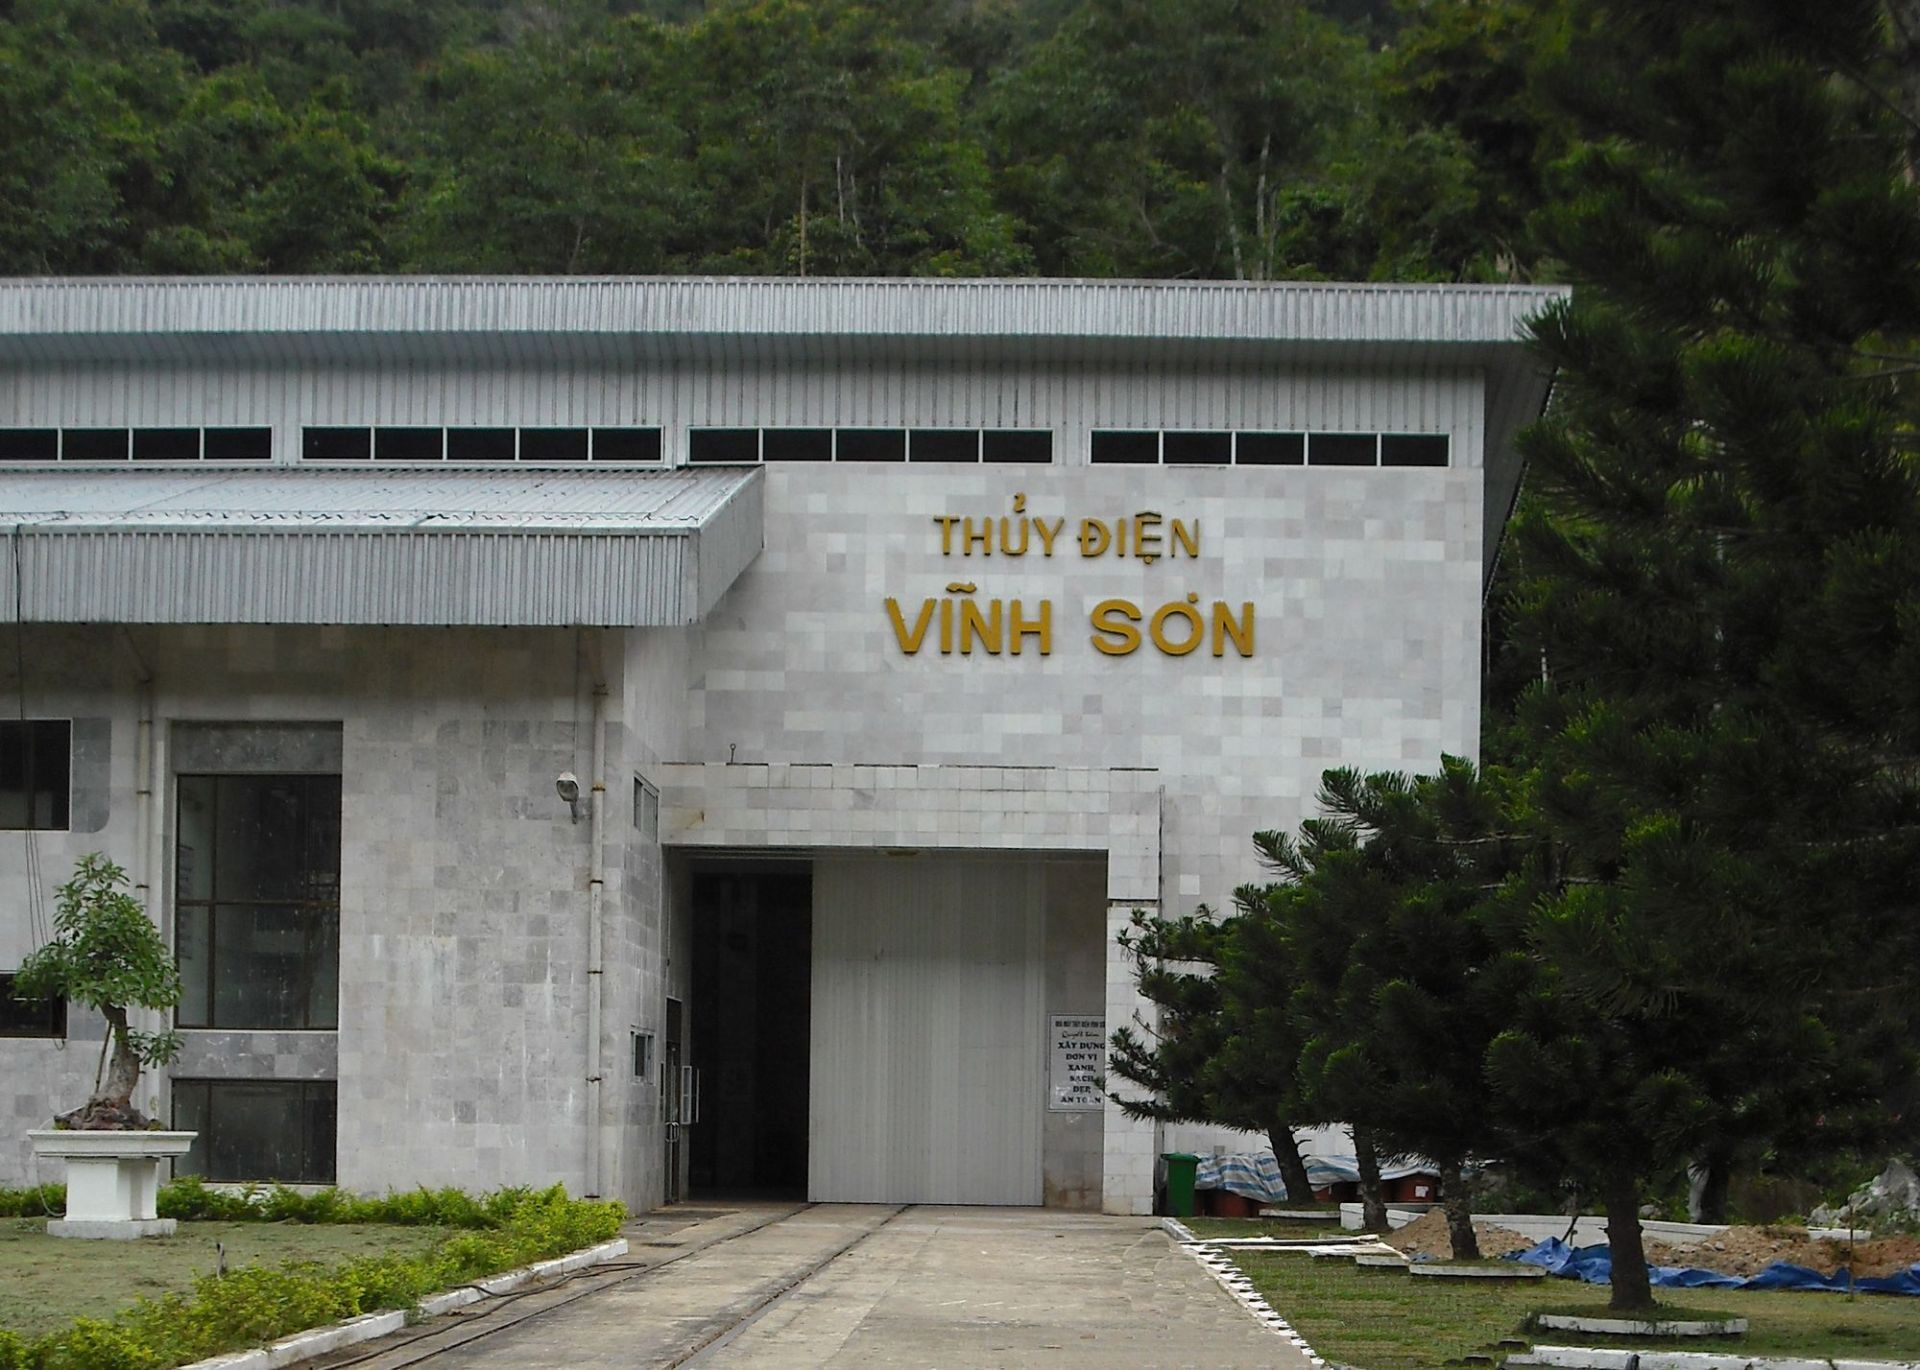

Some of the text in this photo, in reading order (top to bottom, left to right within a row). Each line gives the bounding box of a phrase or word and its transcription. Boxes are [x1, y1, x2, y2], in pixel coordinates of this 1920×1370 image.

[933, 492, 1200, 565] THỦY ĐIỆN
[884, 581, 1255, 658] VĨNH SƠN
[1076, 1096, 1101, 1104] TON
